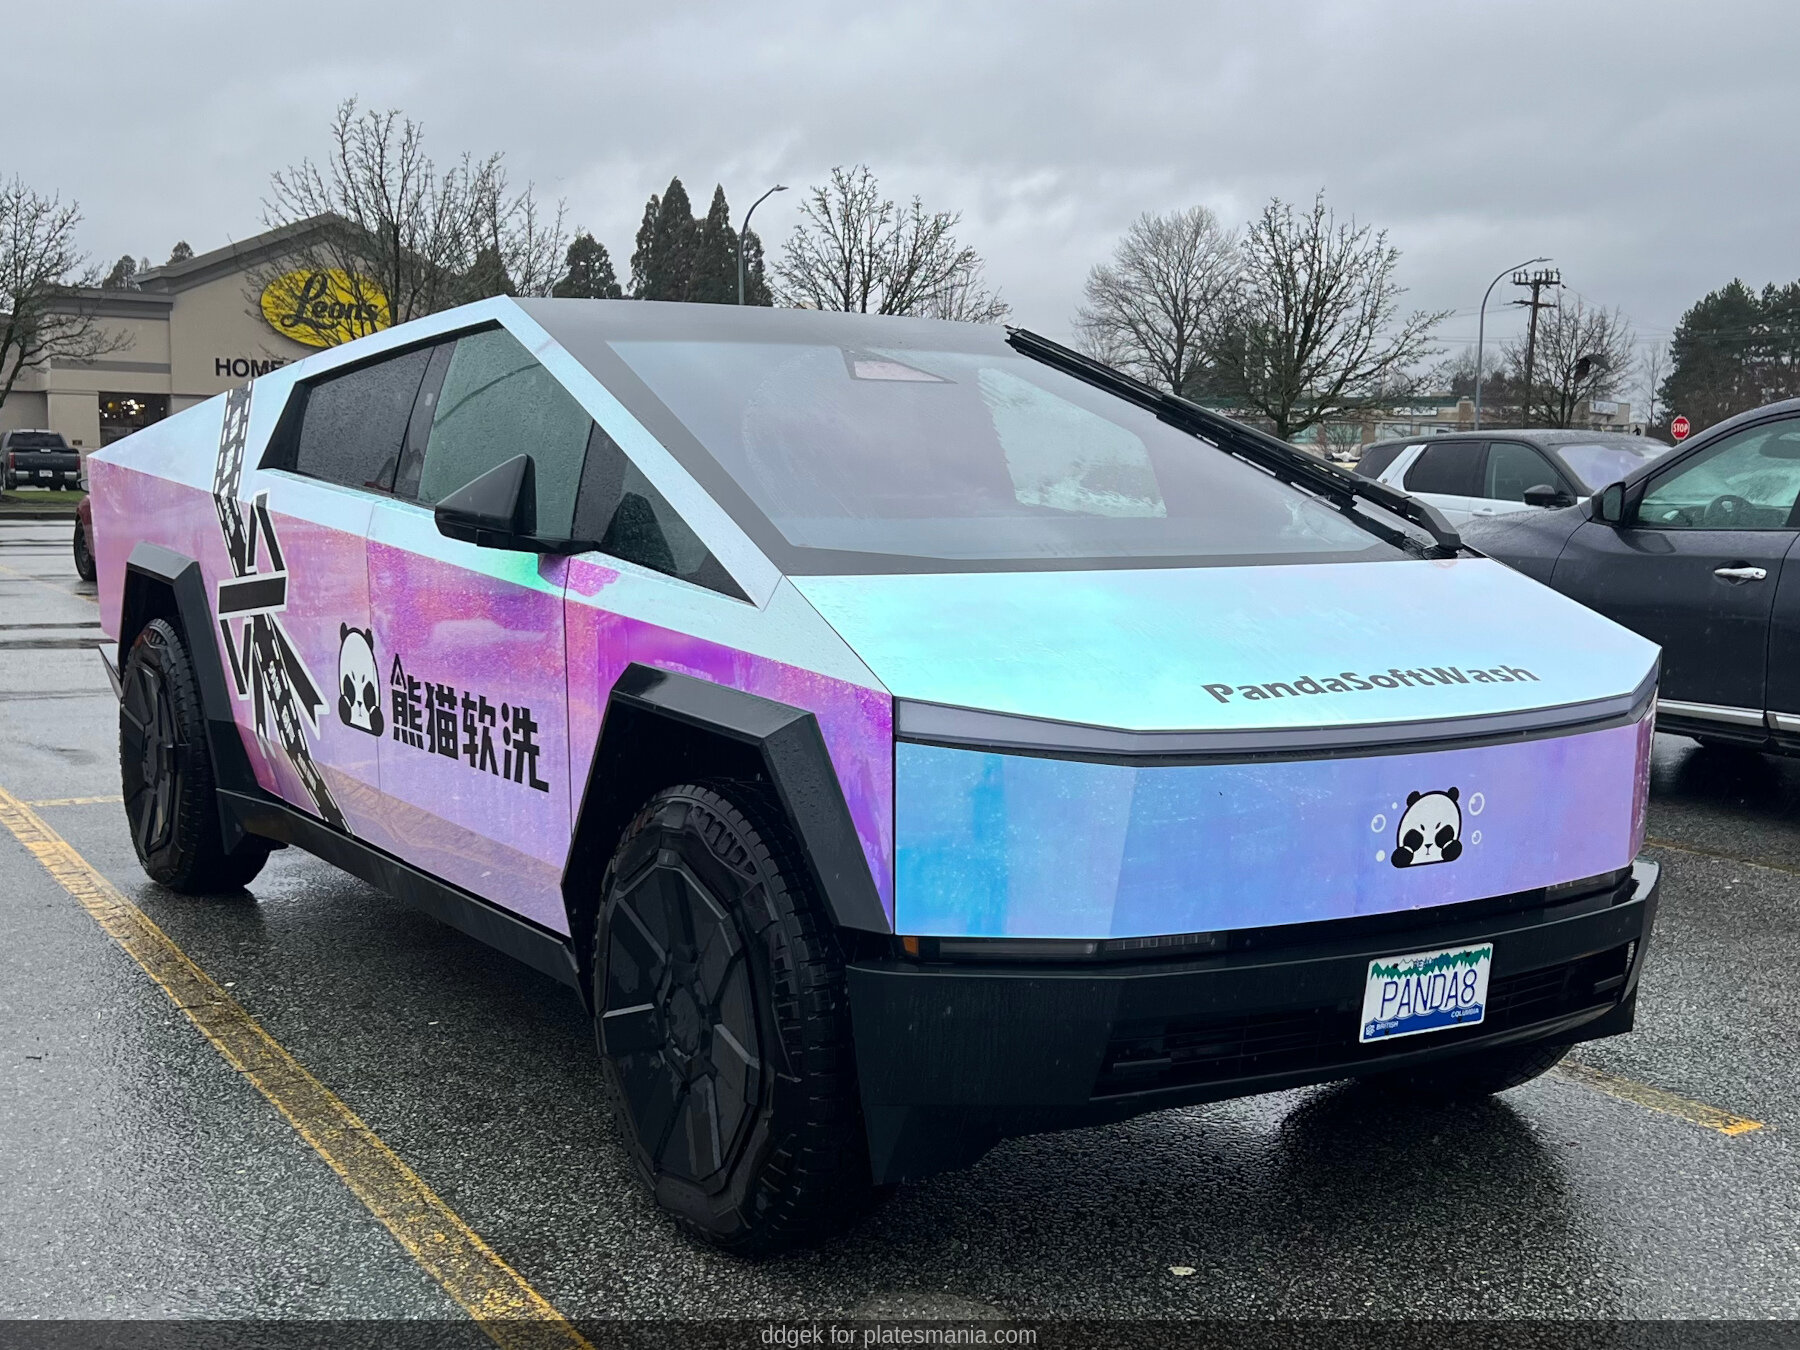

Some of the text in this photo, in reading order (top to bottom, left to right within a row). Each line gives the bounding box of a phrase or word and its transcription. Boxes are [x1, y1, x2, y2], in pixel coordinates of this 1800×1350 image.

[1673, 423, 1689, 433] STOP
[1201, 664, 1541, 704] PandaSoftWash
[1380, 968, 1478, 1018] PANDA8
[1376, 1007, 1480, 1031] BRITISH COLUMBIA
